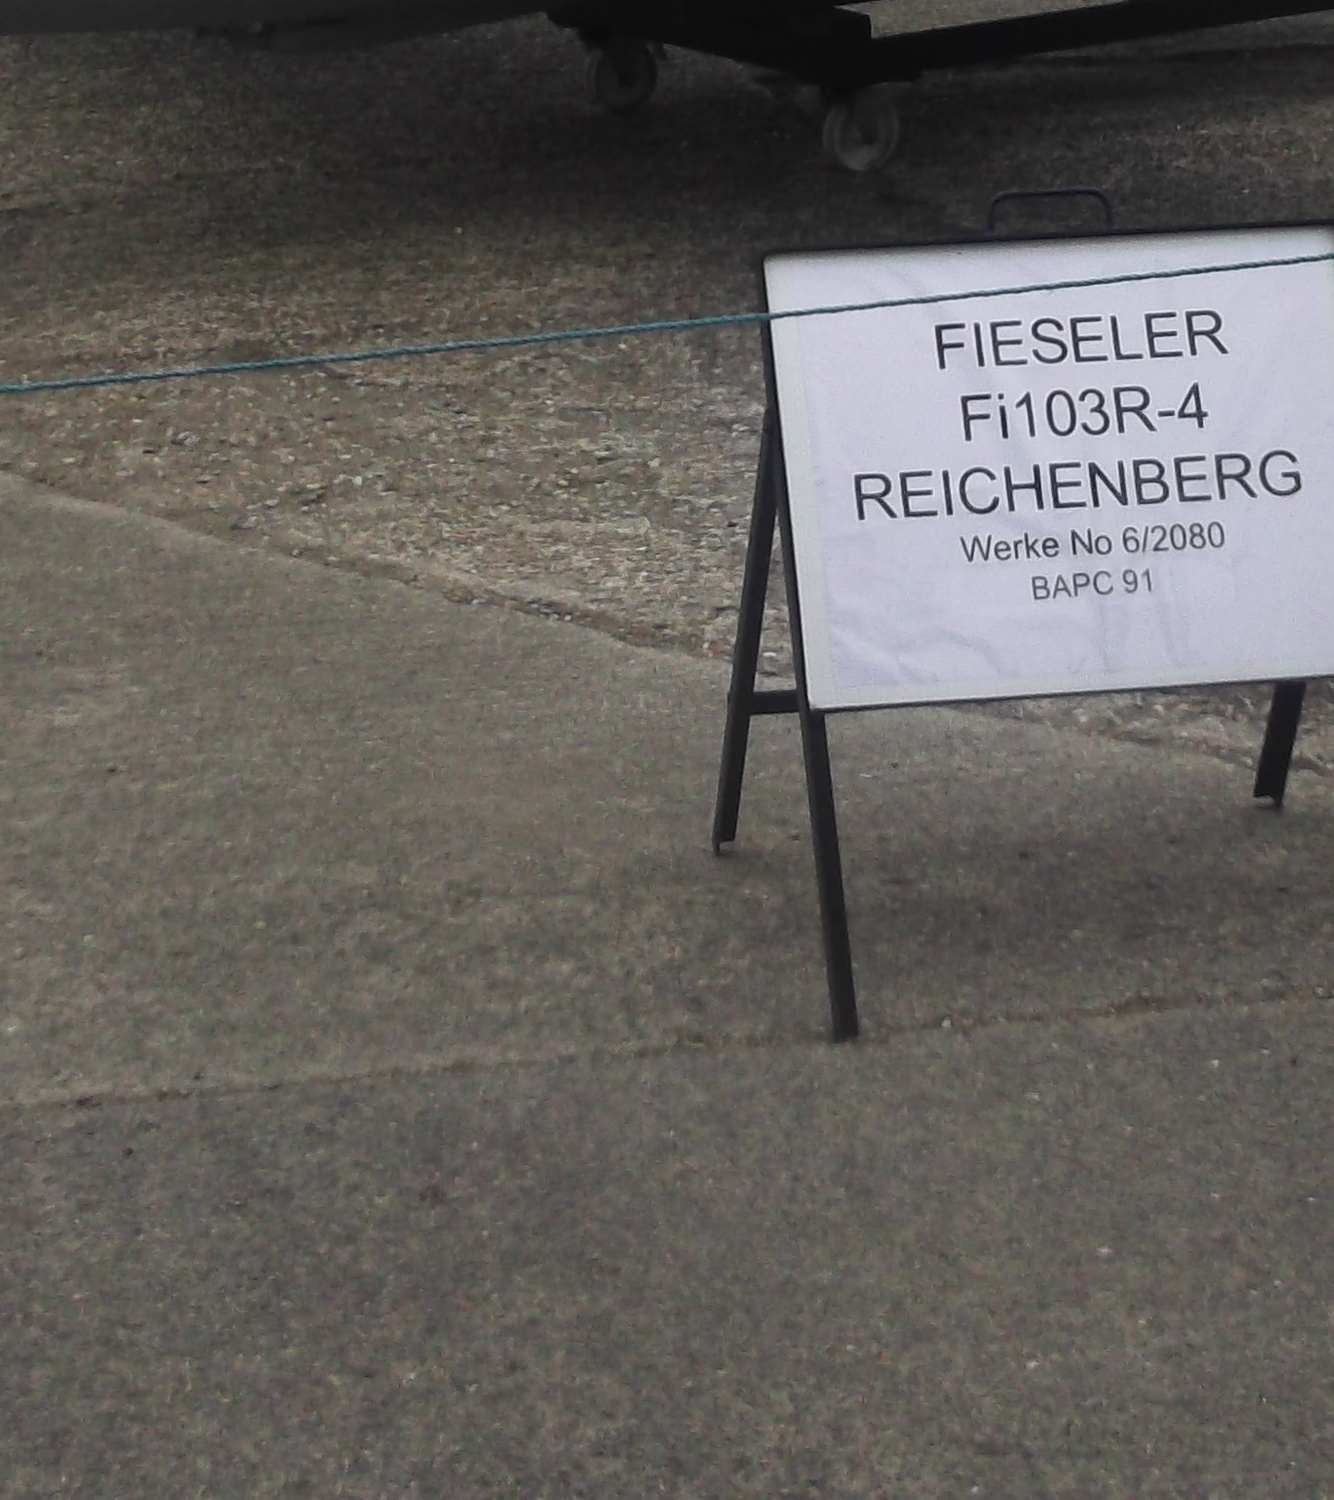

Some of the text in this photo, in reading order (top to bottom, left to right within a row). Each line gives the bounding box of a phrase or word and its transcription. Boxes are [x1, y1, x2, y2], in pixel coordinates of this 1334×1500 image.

[934, 310, 1229, 370] FIESELER
[960, 382, 1209, 442] Fi103R-4
[854, 449, 1303, 521] REICHENBERG
[960, 521, 1225, 563] Werke No 6/2080
[1031, 569, 1154, 600] BAPC 91
